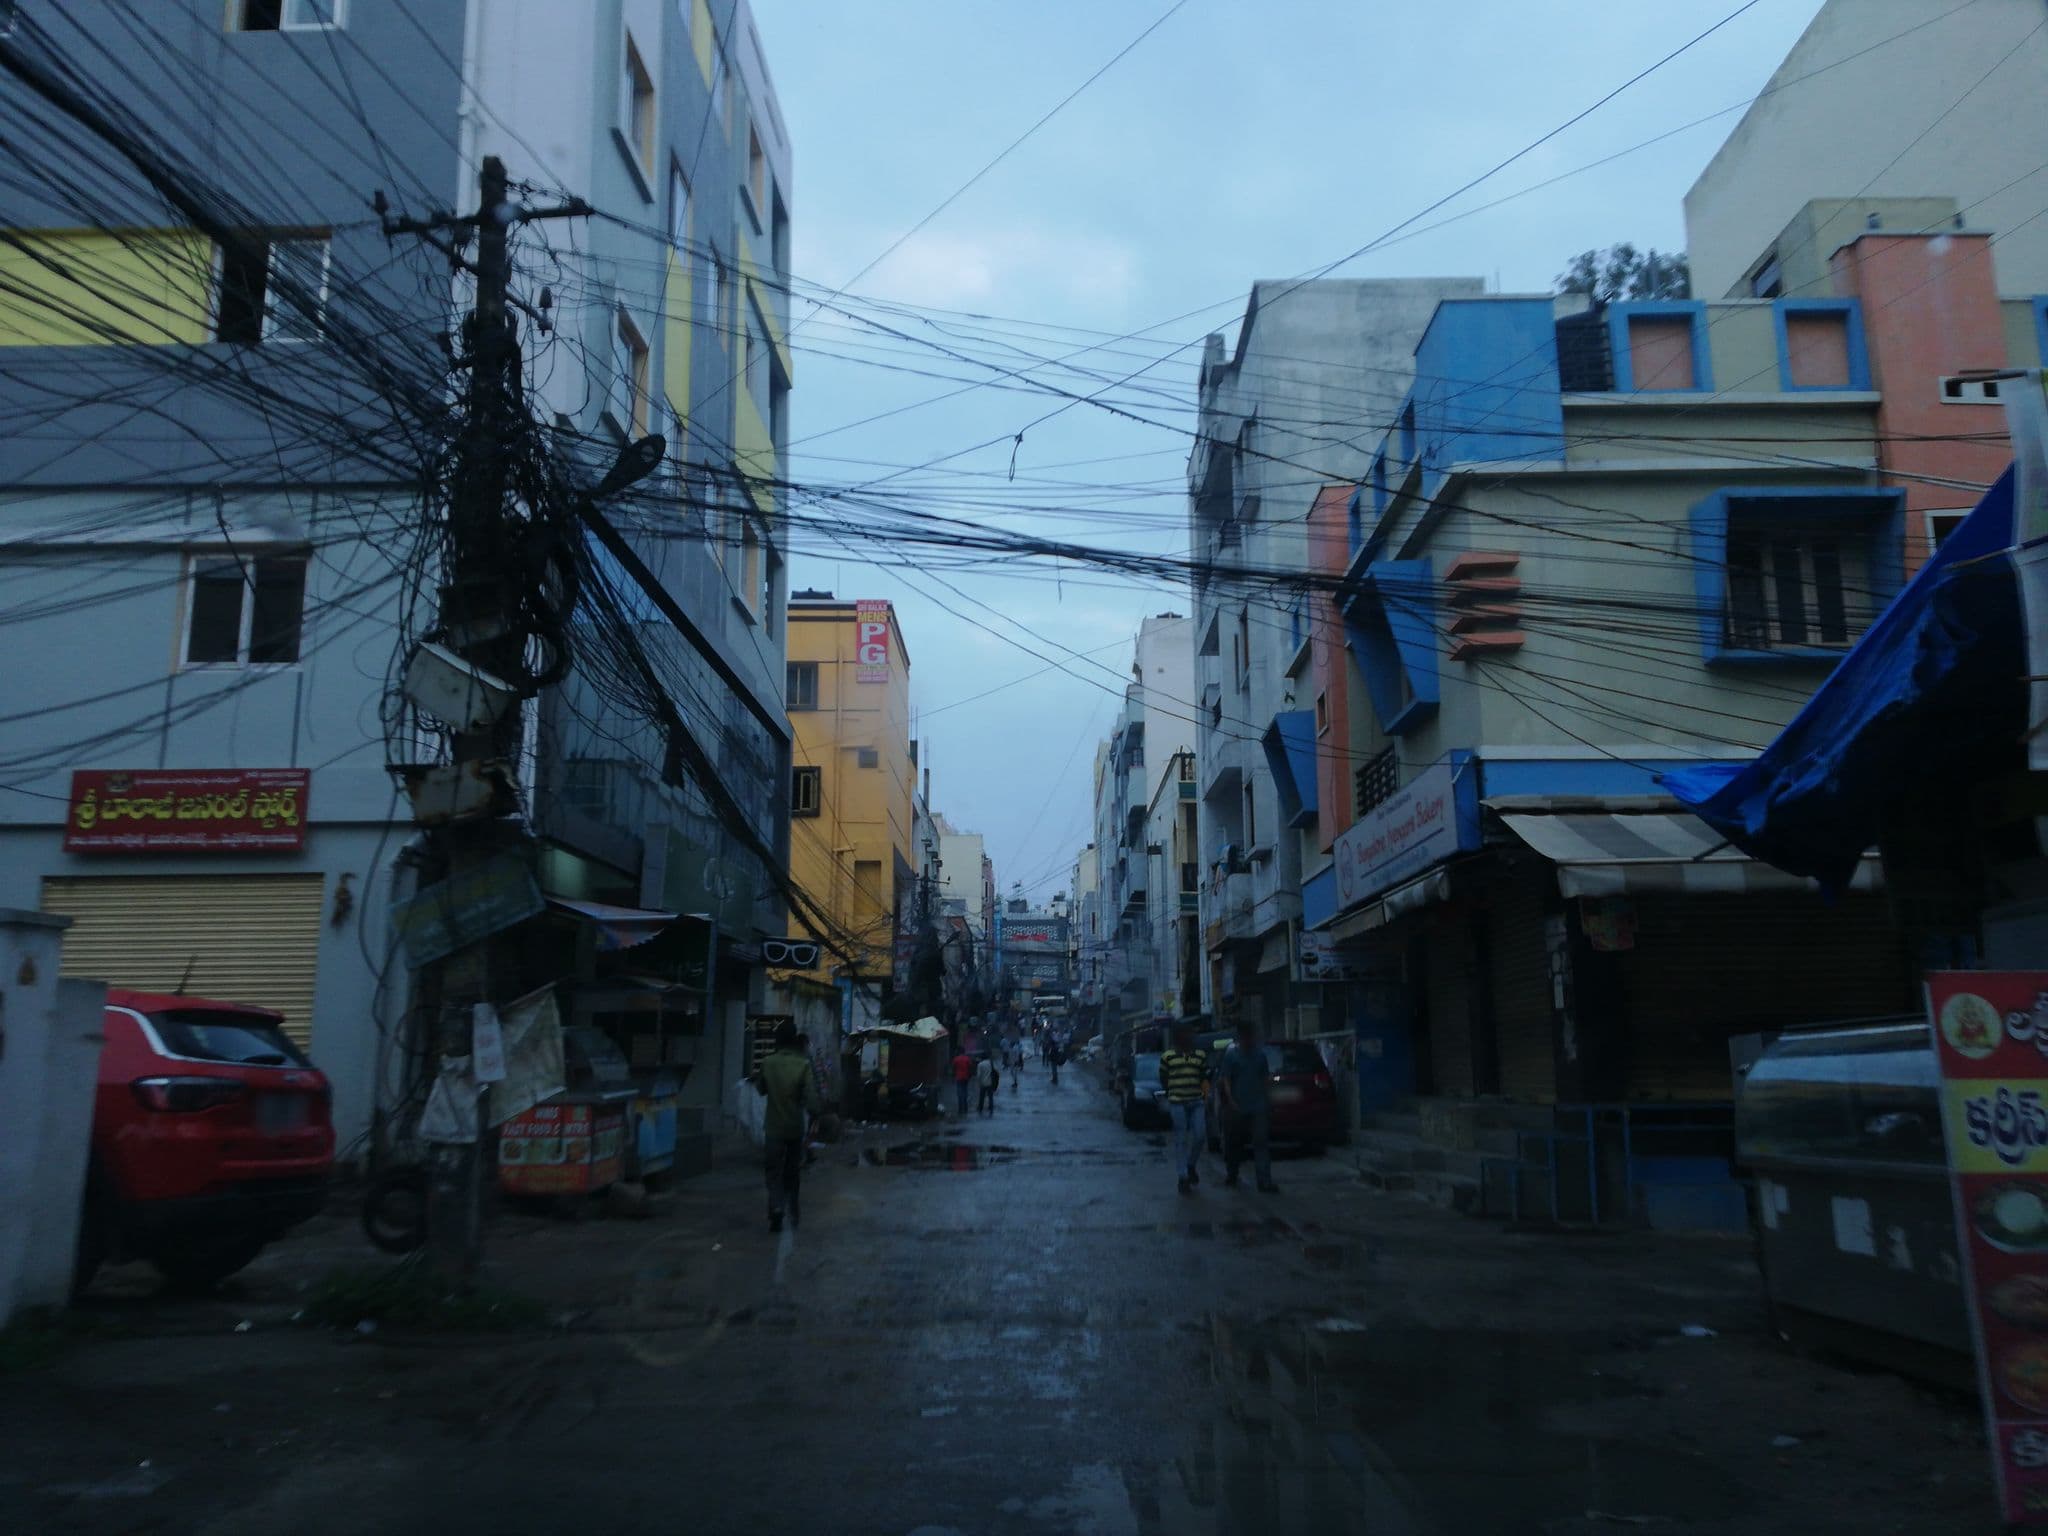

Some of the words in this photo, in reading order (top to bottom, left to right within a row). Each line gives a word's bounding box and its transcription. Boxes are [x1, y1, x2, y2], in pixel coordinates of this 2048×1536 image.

[860, 622, 886, 665] PG
[75, 788, 97, 829] శ్రీ
[100, 789, 175, 820] బాలాజీ
[176, 789, 250, 820] జనరల్
